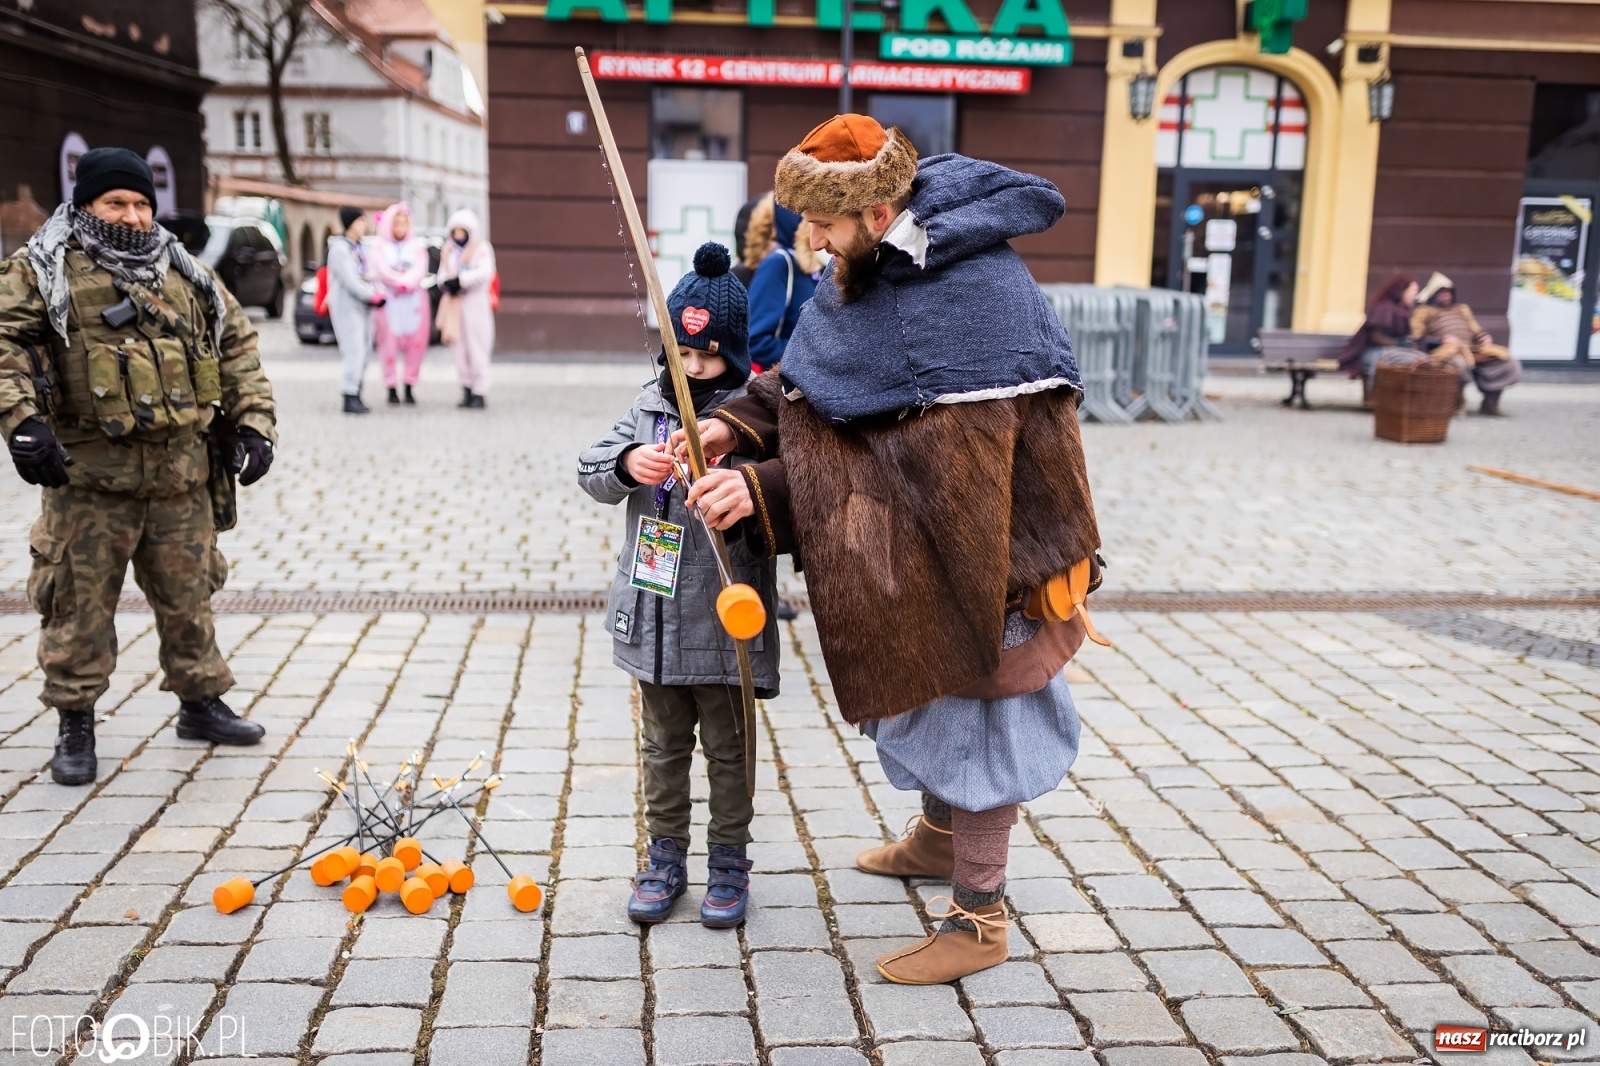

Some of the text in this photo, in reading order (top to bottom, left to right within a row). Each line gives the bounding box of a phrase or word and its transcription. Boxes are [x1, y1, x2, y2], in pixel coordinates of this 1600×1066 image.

[890, 37, 1065, 63] POD RÓŻAMI
[598, 55, 675, 78] RYNEK
[678, 58, 707, 79] 12
[719, 60, 825, 82] CENTRUM
[643, 524, 658, 534] 30
